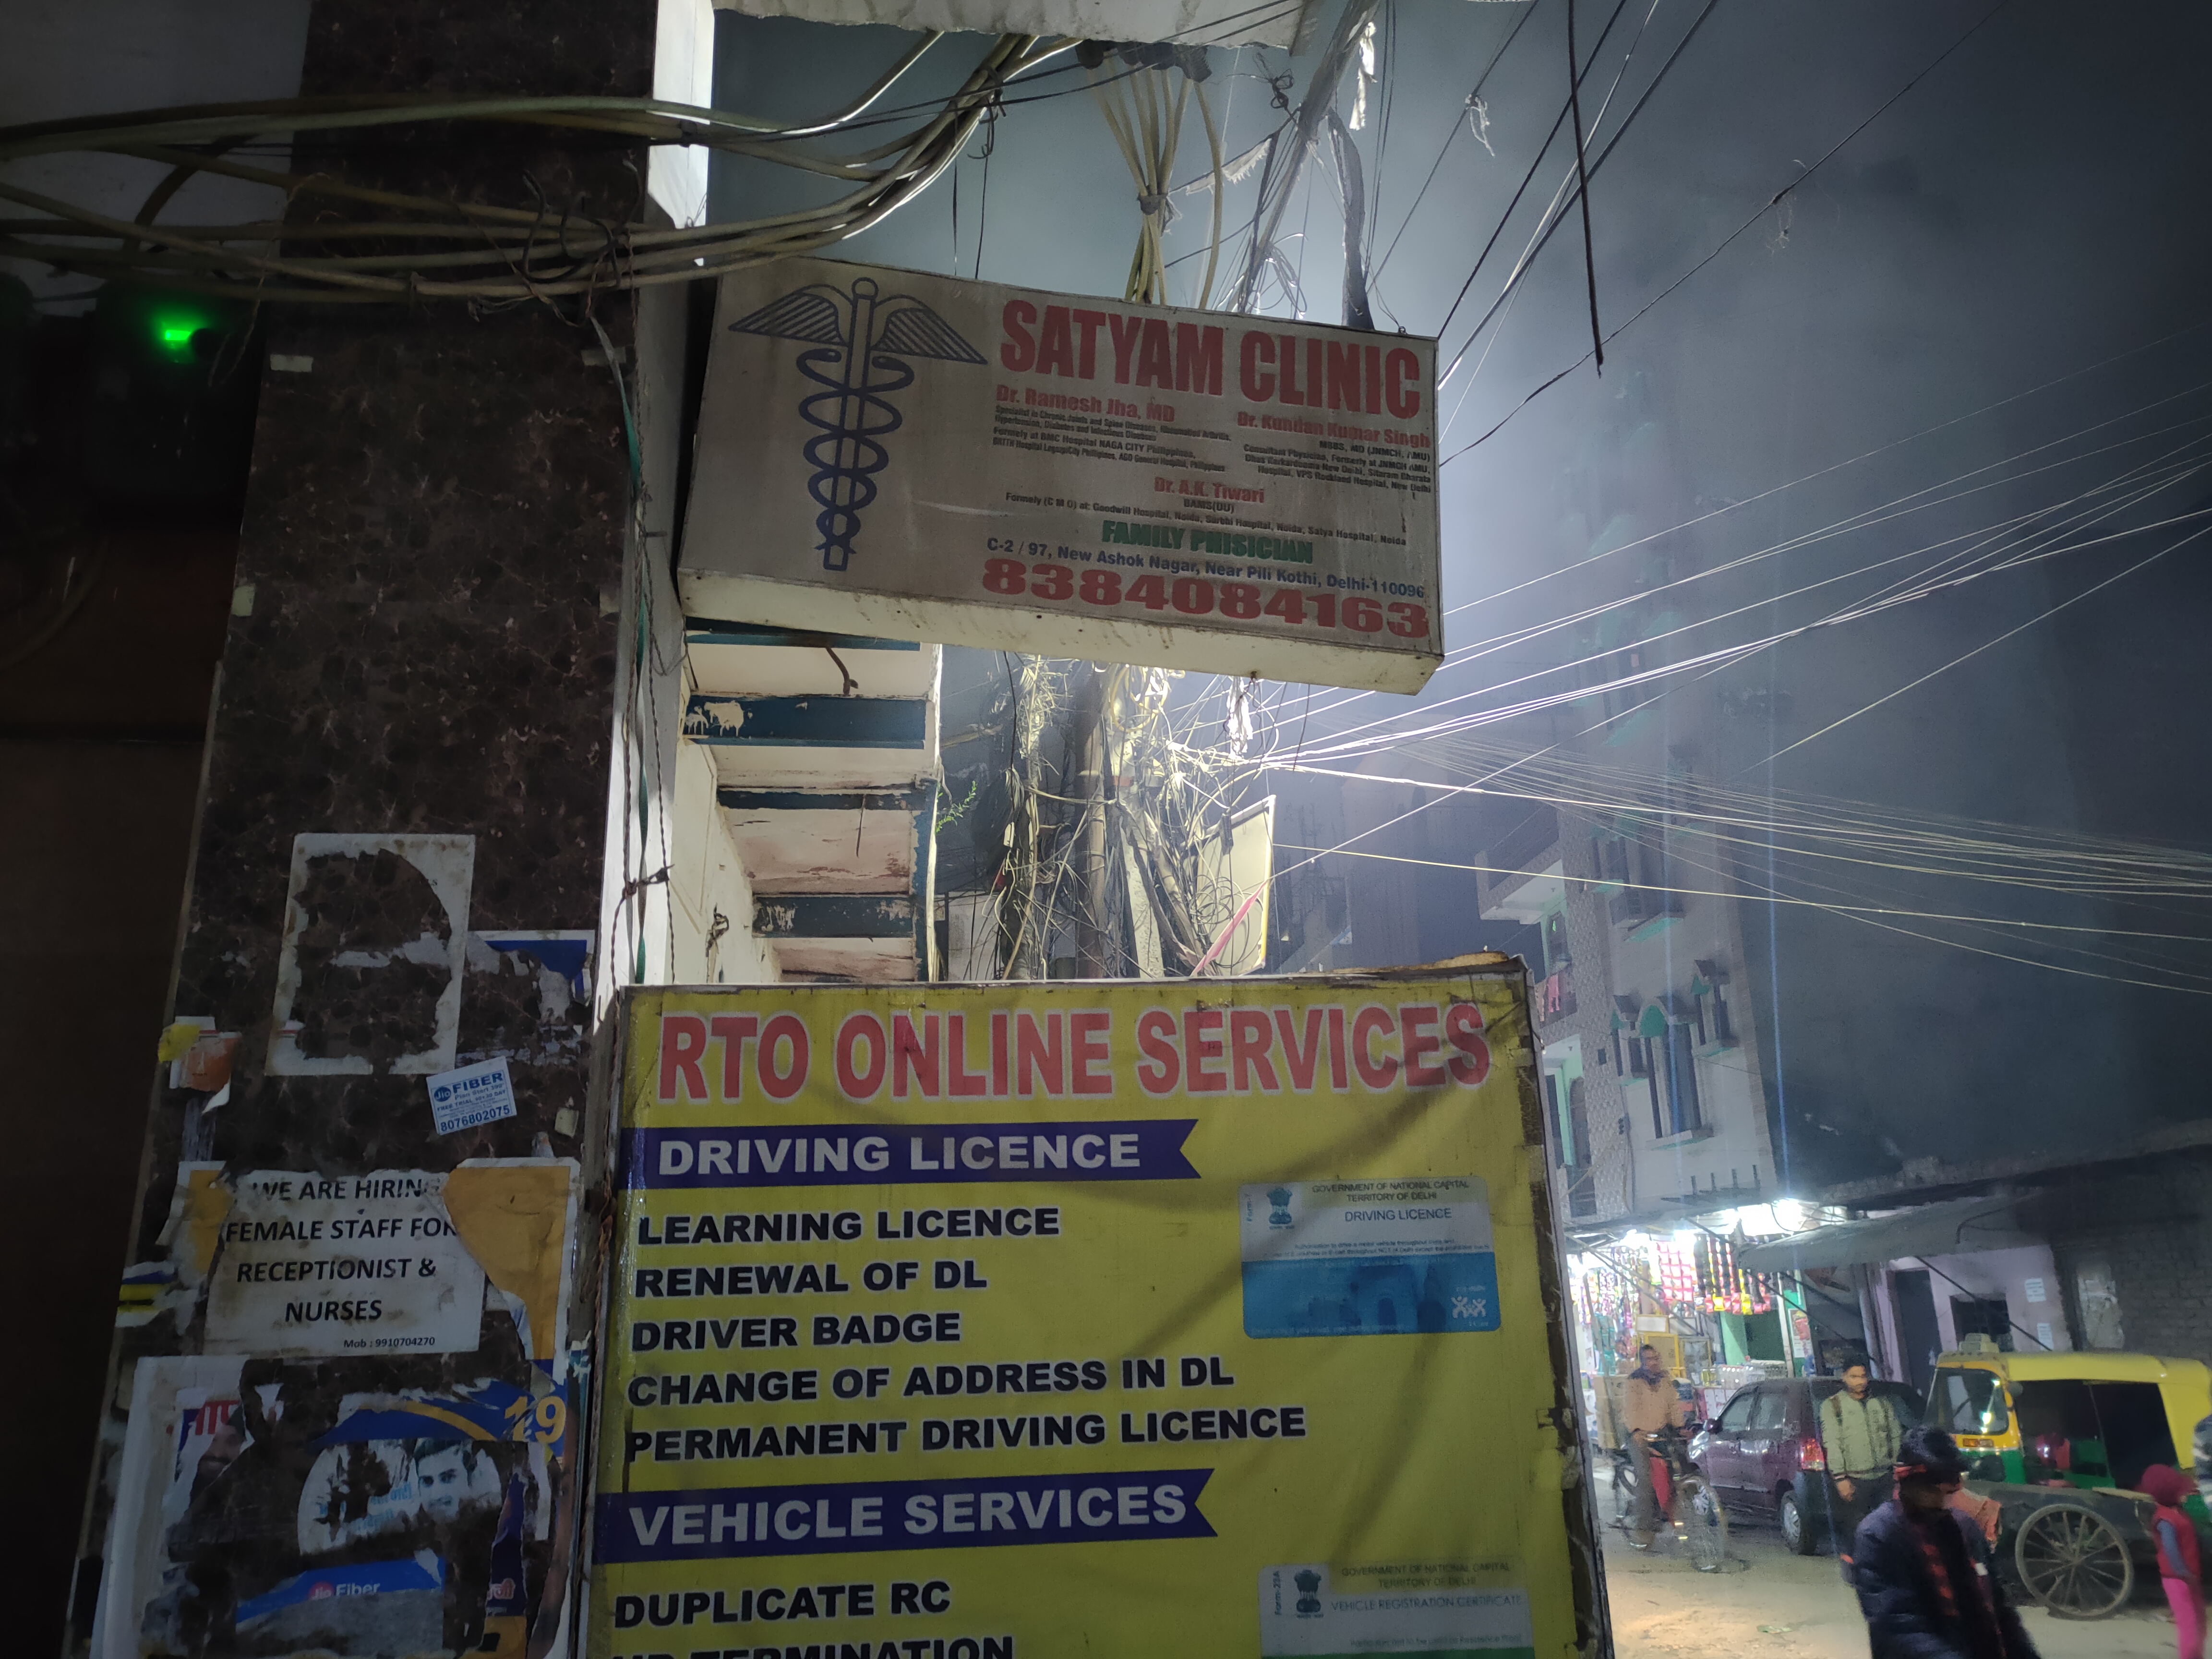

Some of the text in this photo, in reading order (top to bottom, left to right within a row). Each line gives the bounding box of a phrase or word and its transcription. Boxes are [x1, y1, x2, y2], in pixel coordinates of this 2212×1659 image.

[1000, 299, 1420, 419] SATYAM CLINIC
[997, 384, 1175, 422] Dr. Ramesh Jha, MD
[1238, 411, 1431, 448] Dr. Kundan Kumar Singh
[1016, 440, 1042, 450] Hospital
[1062, 434, 1097, 446] Hospital
[1099, 440, 1123, 450] NAGA
[1125, 443, 1144, 452] CITY
[1244, 444, 1286, 456] Consultant
[1319, 440, 1347, 452] MBBS,
[1322, 463, 1339, 472] New
[1154, 476, 1264, 504] Dr. A.K. Tiwari
[1297, 470, 1312, 479] VPS
[1391, 481, 1407, 490] New
[1410, 483, 1431, 493] Delhi
[1006, 492, 1042, 506] Formely
[1093, 502, 1130, 515] Goodwill
[1308, 526, 1333, 537] Satya
[1380, 535, 1407, 546] Noida
[1103, 520, 1313, 564] FAMILY PHISICIAN
[987, 537, 1013, 553] C-2
[1028, 542, 1052, 559] 97,
[1058, 546, 1092, 562] New
[1097, 551, 1143, 567] Ashok
[1149, 556, 1200, 575] Nagar,
[1205, 561, 1243, 577] Near
[1247, 565, 1271, 581] Pili
[1276, 568, 1321, 588] Kothi,
[1327, 574, 1424, 598] Delhi-110096
[983, 557, 1429, 639] 8384084163
[658, 1004, 1490, 1100] RTO ONLINE SERVICES
[453, 1072, 503, 1094] FIBER
[440, 1105, 510, 1131] 8076802075
[659, 1133, 1140, 1176] DRIVING LICENCE
[298, 1180, 347, 1200] ARE
[1312, 1179, 1470, 1193] GOVERNMENT OF NATIONAL CAPITAL
[1346, 1193, 1395, 1202] TERRITORY
[1411, 1191, 1437, 1200] DELHI
[638, 1208, 1059, 1245] LEARNING LICENCE
[1345, 1207, 1452, 1222] DRIVING LICENCE
[226, 1221, 324, 1242] FEMALE
[330, 1218, 403, 1239] STAFF
[237, 1258, 436, 1282] RECEPTIONIST &
[635, 1261, 987, 1298] RENEWAL OF DL
[285, 1299, 382, 1322] NURSES
[344, 1339, 366, 1348] Mob
[375, 1337, 435, 1347] 9910704270
[632, 1313, 961, 1352] DRIVER BADGE
[627, 1357, 1234, 1407] CHANGE OF ADDRESS IN DL
[505, 1396, 566, 1443] 19
[628, 1407, 1306, 1463] PERMANENT DRIVING LICENCE
[629, 1484, 1187, 1546] VEHICLE SERVICES
[1342, 1564, 1407, 1576] GOVERNMENT
[1409, 1564, 1421, 1573] OF
[336, 1583, 381, 1596] Fiber
[614, 1581, 950, 1629] DUPLICATE RC
[1331, 1595, 1521, 1611] VEHICLE REGISTRATION CERTIFICATE
[690, 1636, 1013, 1659] NATION
